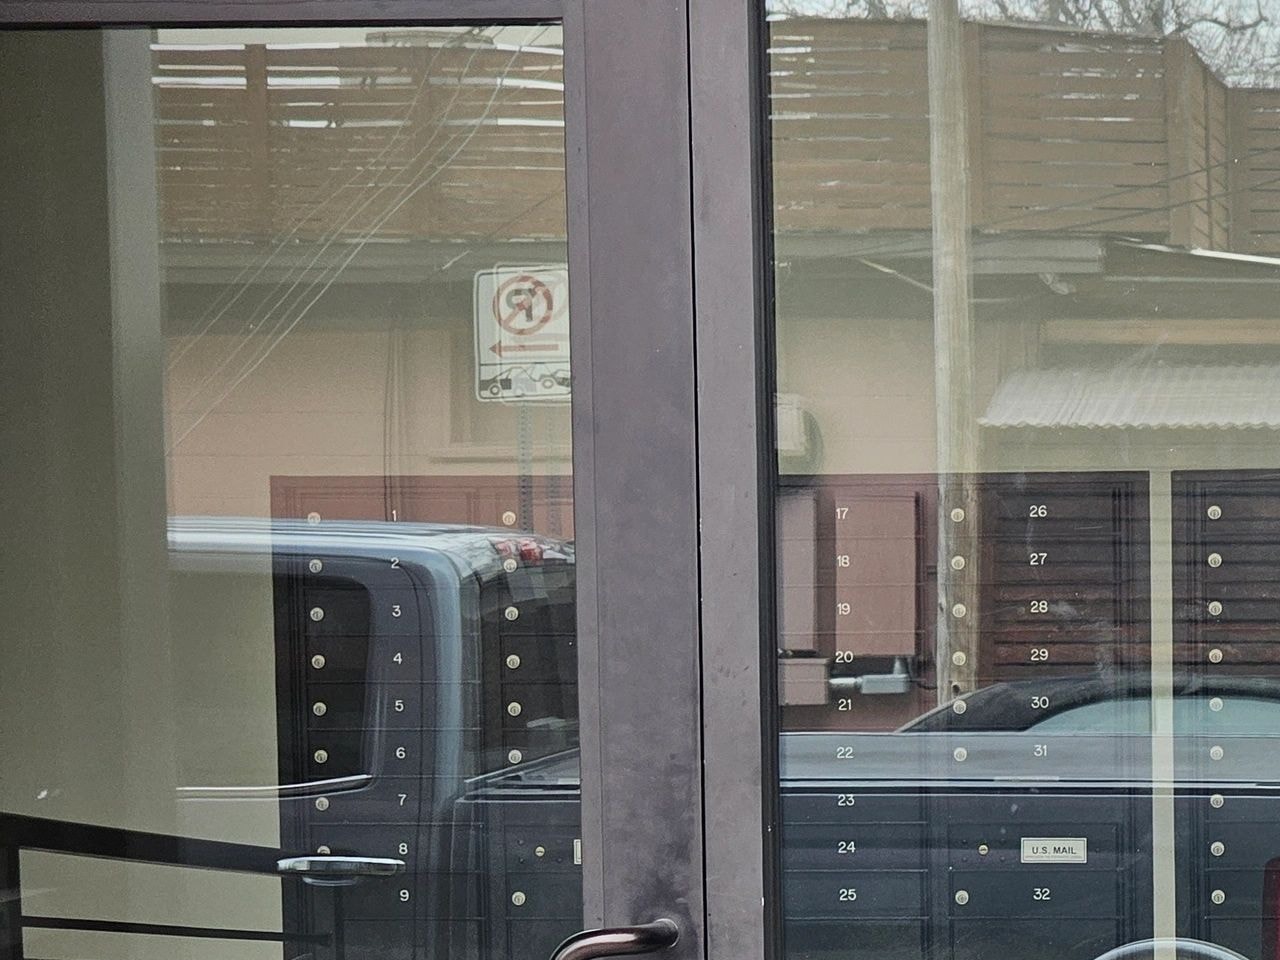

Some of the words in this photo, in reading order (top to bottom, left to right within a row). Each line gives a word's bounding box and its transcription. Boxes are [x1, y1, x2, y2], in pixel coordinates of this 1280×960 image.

[391, 509, 397, 522] 1
[835, 507, 849, 520] 17
[1029, 504, 1048, 518] 26
[390, 556, 401, 569] 2
[836, 554, 850, 568] 18
[1029, 552, 1048, 566] 27
[391, 604, 402, 618] 3
[836, 602, 851, 616] 19
[1030, 600, 1049, 613] 28
[392, 652, 403, 665] 4
[835, 650, 854, 663] 20
[1030, 648, 1049, 661] 29
[394, 699, 404, 712] 5
[838, 698, 852, 711] 21
[1030, 696, 1050, 709] 30
[395, 746, 406, 759] 6
[836, 746, 854, 759] 22
[1033, 744, 1048, 757] 31
[397, 793, 407, 806] 7
[836, 793, 856, 807] 23
[398, 842, 408, 855] 8
[837, 841, 856, 854] 24
[1031, 846, 1051, 855] U.S.
[1052, 846, 1077, 855] MAIL
[399, 889, 410, 902] 9
[839, 888, 857, 901] 25
[1032, 887, 1051, 901] 32
